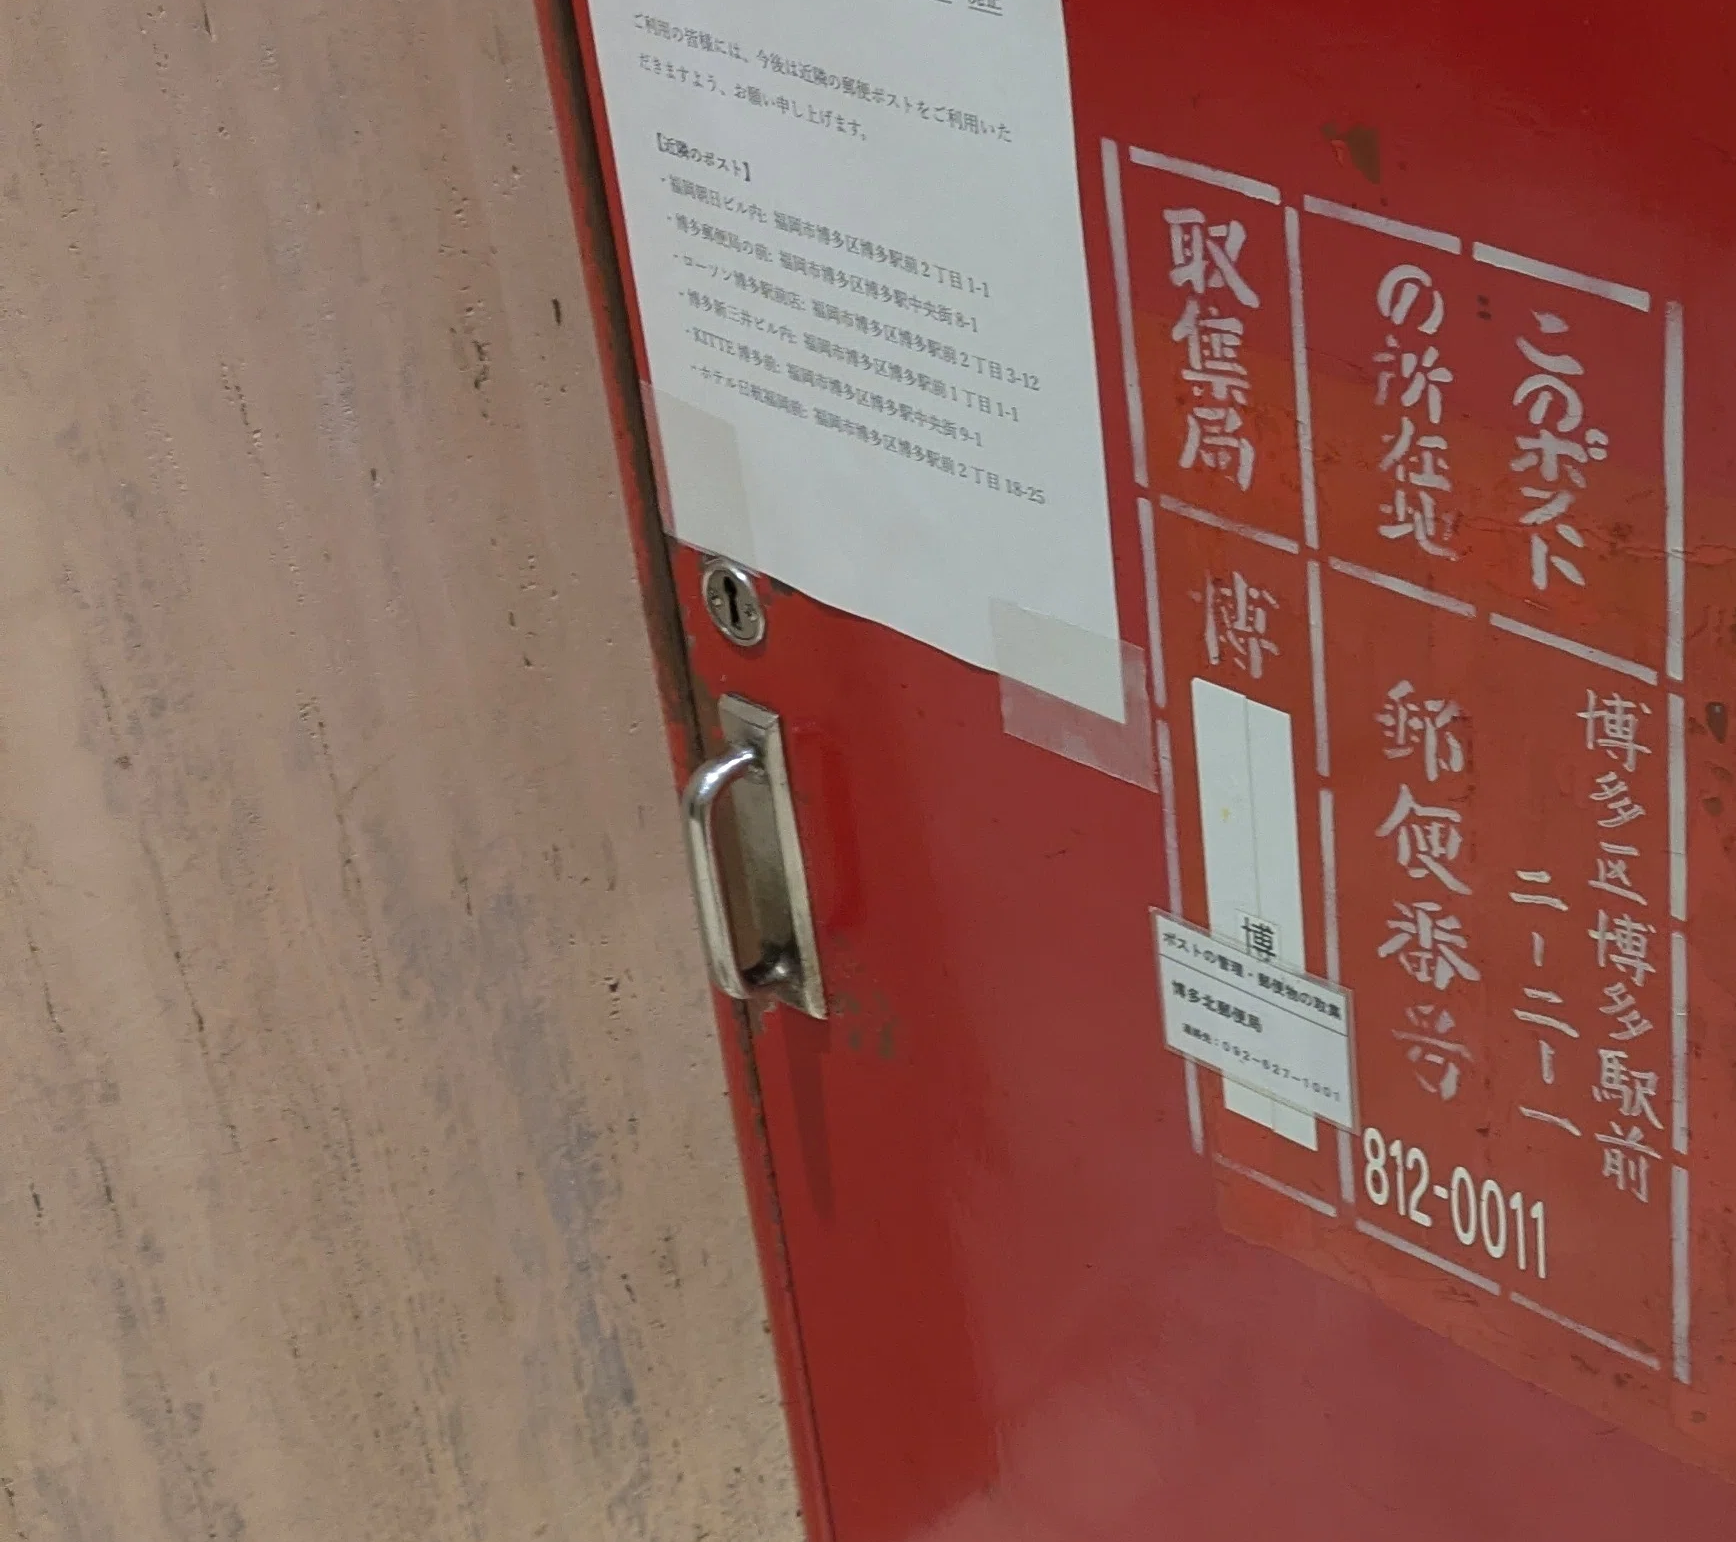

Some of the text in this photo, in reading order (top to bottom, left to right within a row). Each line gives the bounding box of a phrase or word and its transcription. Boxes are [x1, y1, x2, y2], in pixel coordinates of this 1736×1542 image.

[638, 52, 868, 142] だきますよう、お願い申し上げます。
[656, 131, 751, 182] 【近隣のポスト】
[1162, 207, 1261, 493] 取集局
[1372, 263, 1459, 561] の所在地
[1509, 308, 1610, 591] このポスト
[1373, 678, 1482, 1102] 郵便番号
[1575, 688, 1664, 1204] 博多区博多駅前
[1362, 1125, 1548, 1280] 812-0011
